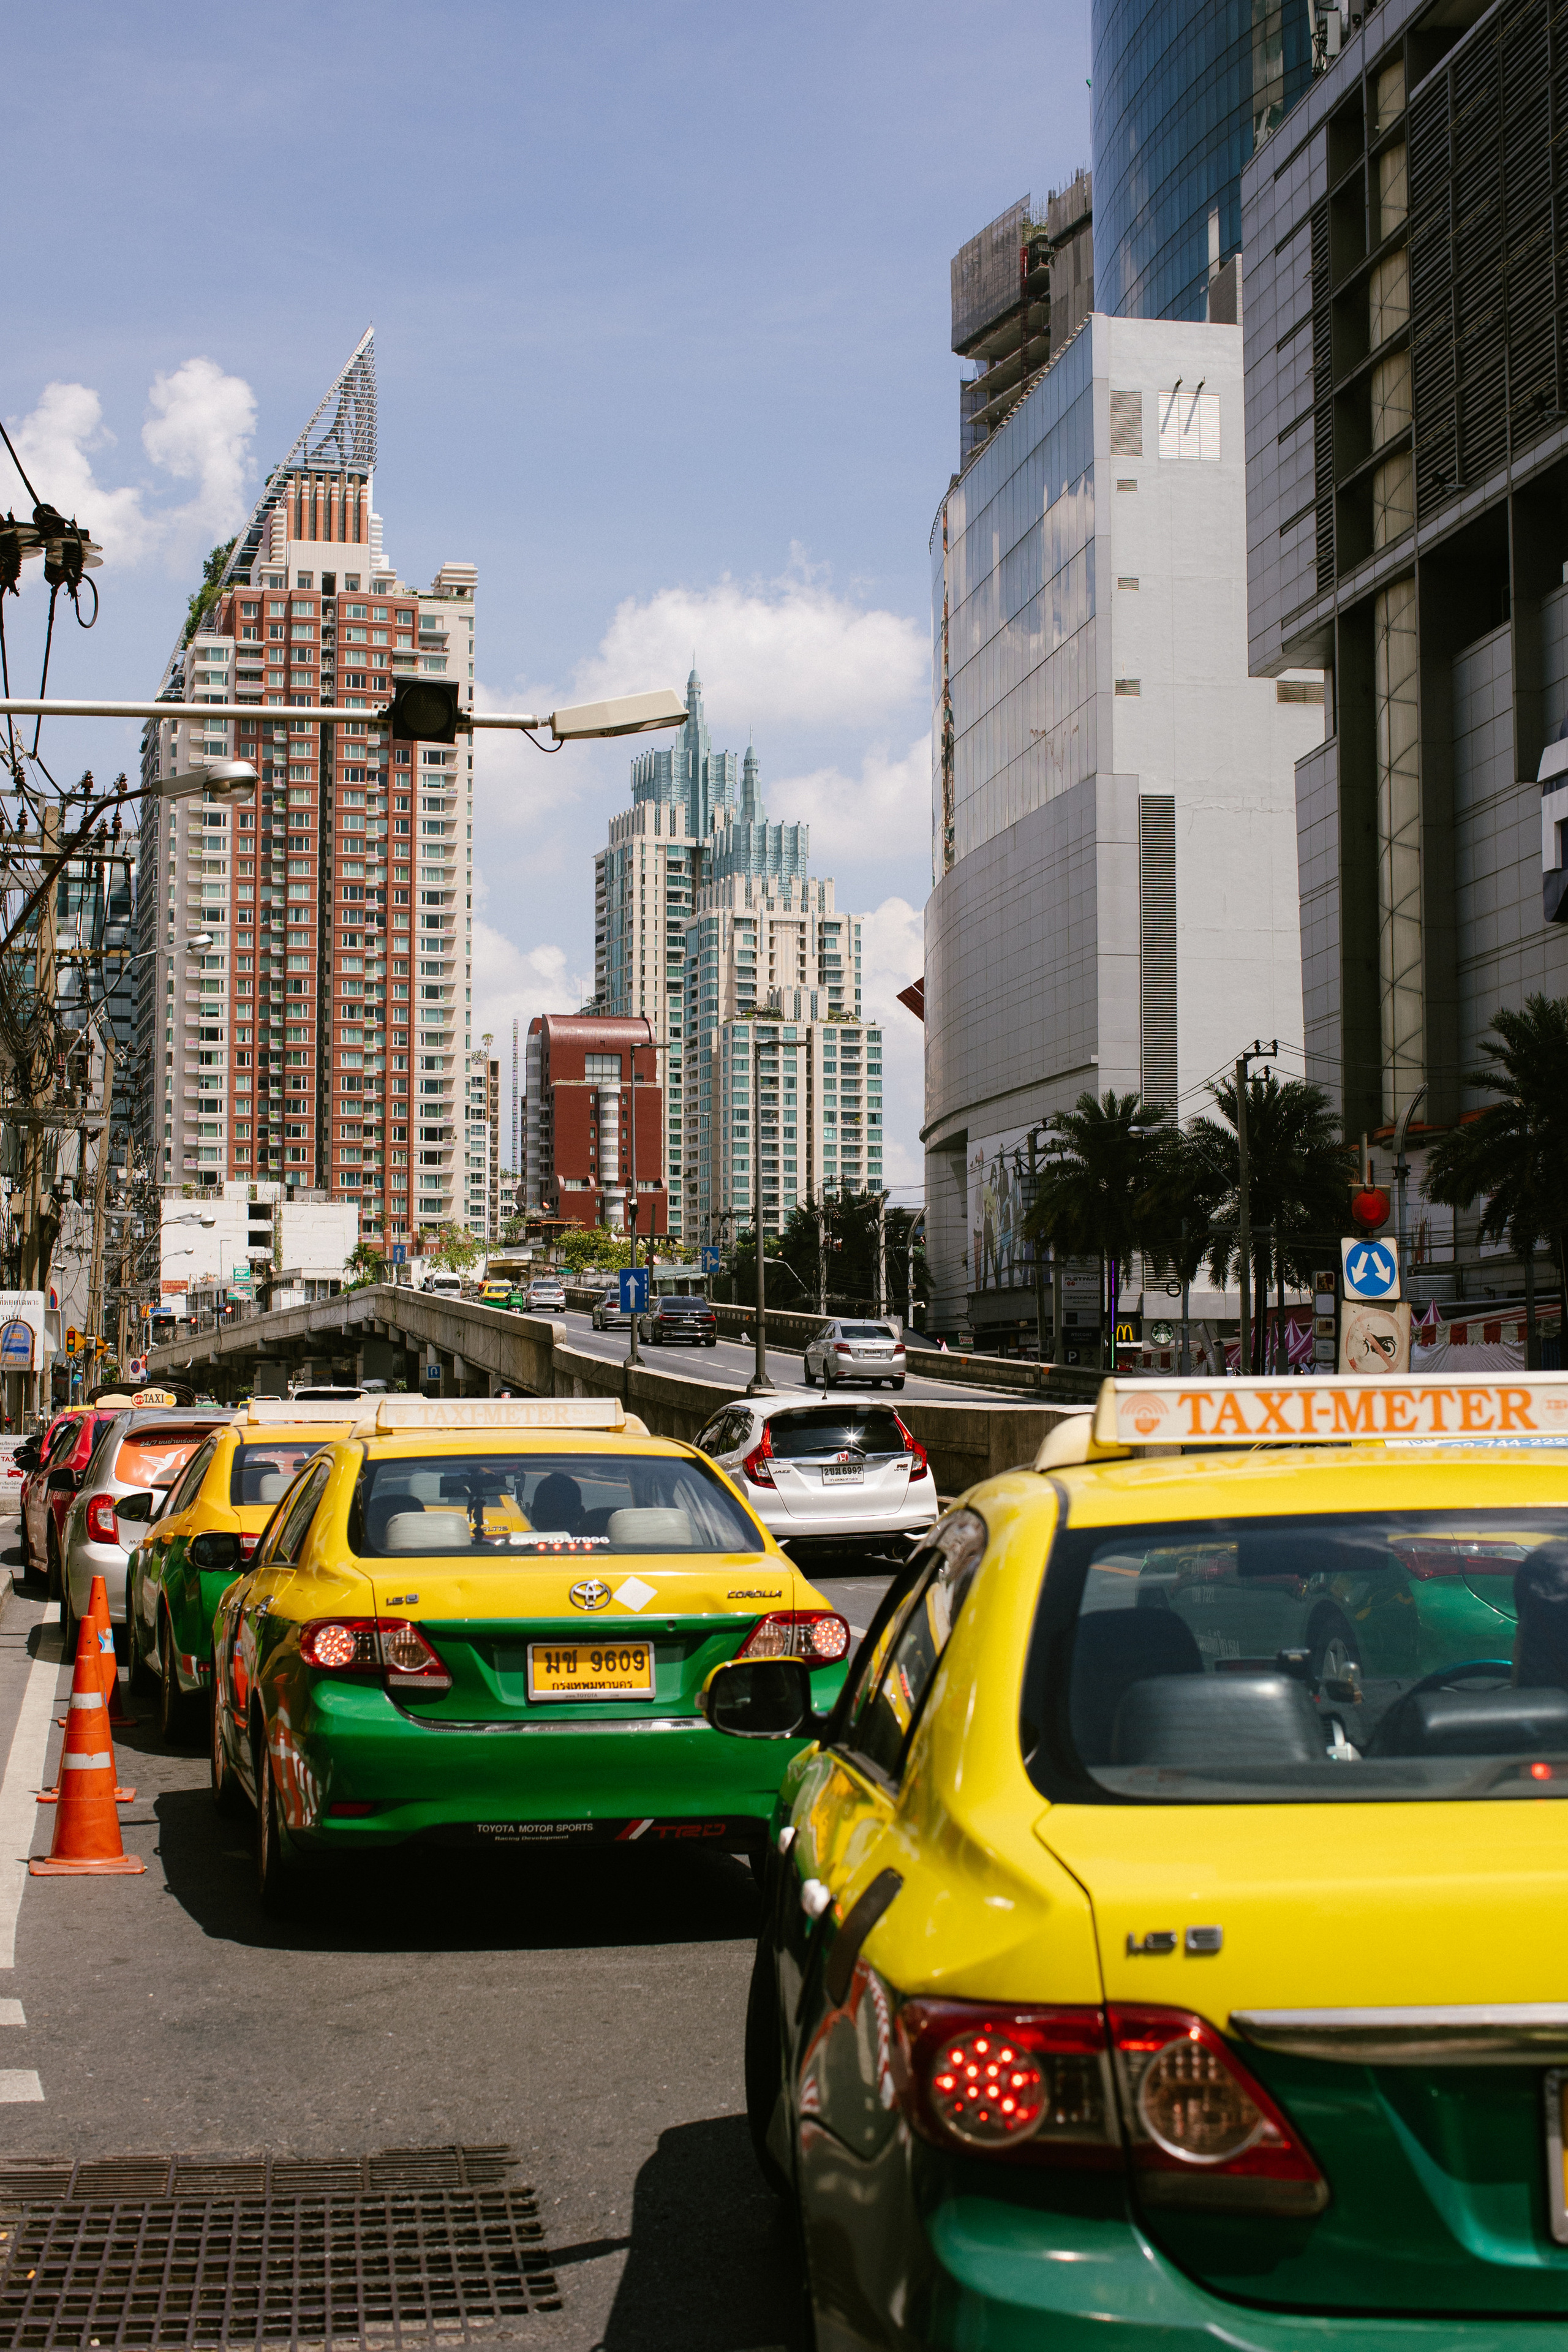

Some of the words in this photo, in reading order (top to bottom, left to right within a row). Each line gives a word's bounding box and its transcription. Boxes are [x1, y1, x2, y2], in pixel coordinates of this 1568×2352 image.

[1068, 1351, 1077, 1363] P
[143, 1393, 164, 1403] TAXI
[418, 1404, 571, 1425] TAXI-METER
[1177, 1387, 1538, 1435] TAXI-METER
[842, 1466, 862, 1475] 6992
[727, 1590, 782, 1599] COROLLA
[590, 1649, 645, 1672] 9609
[477, 1824, 514, 1833] TOYOTA
[518, 1824, 553, 1833] MOTOR
[556, 1823, 594, 1832] SPORTS
[650, 1823, 726, 1838] TRD
